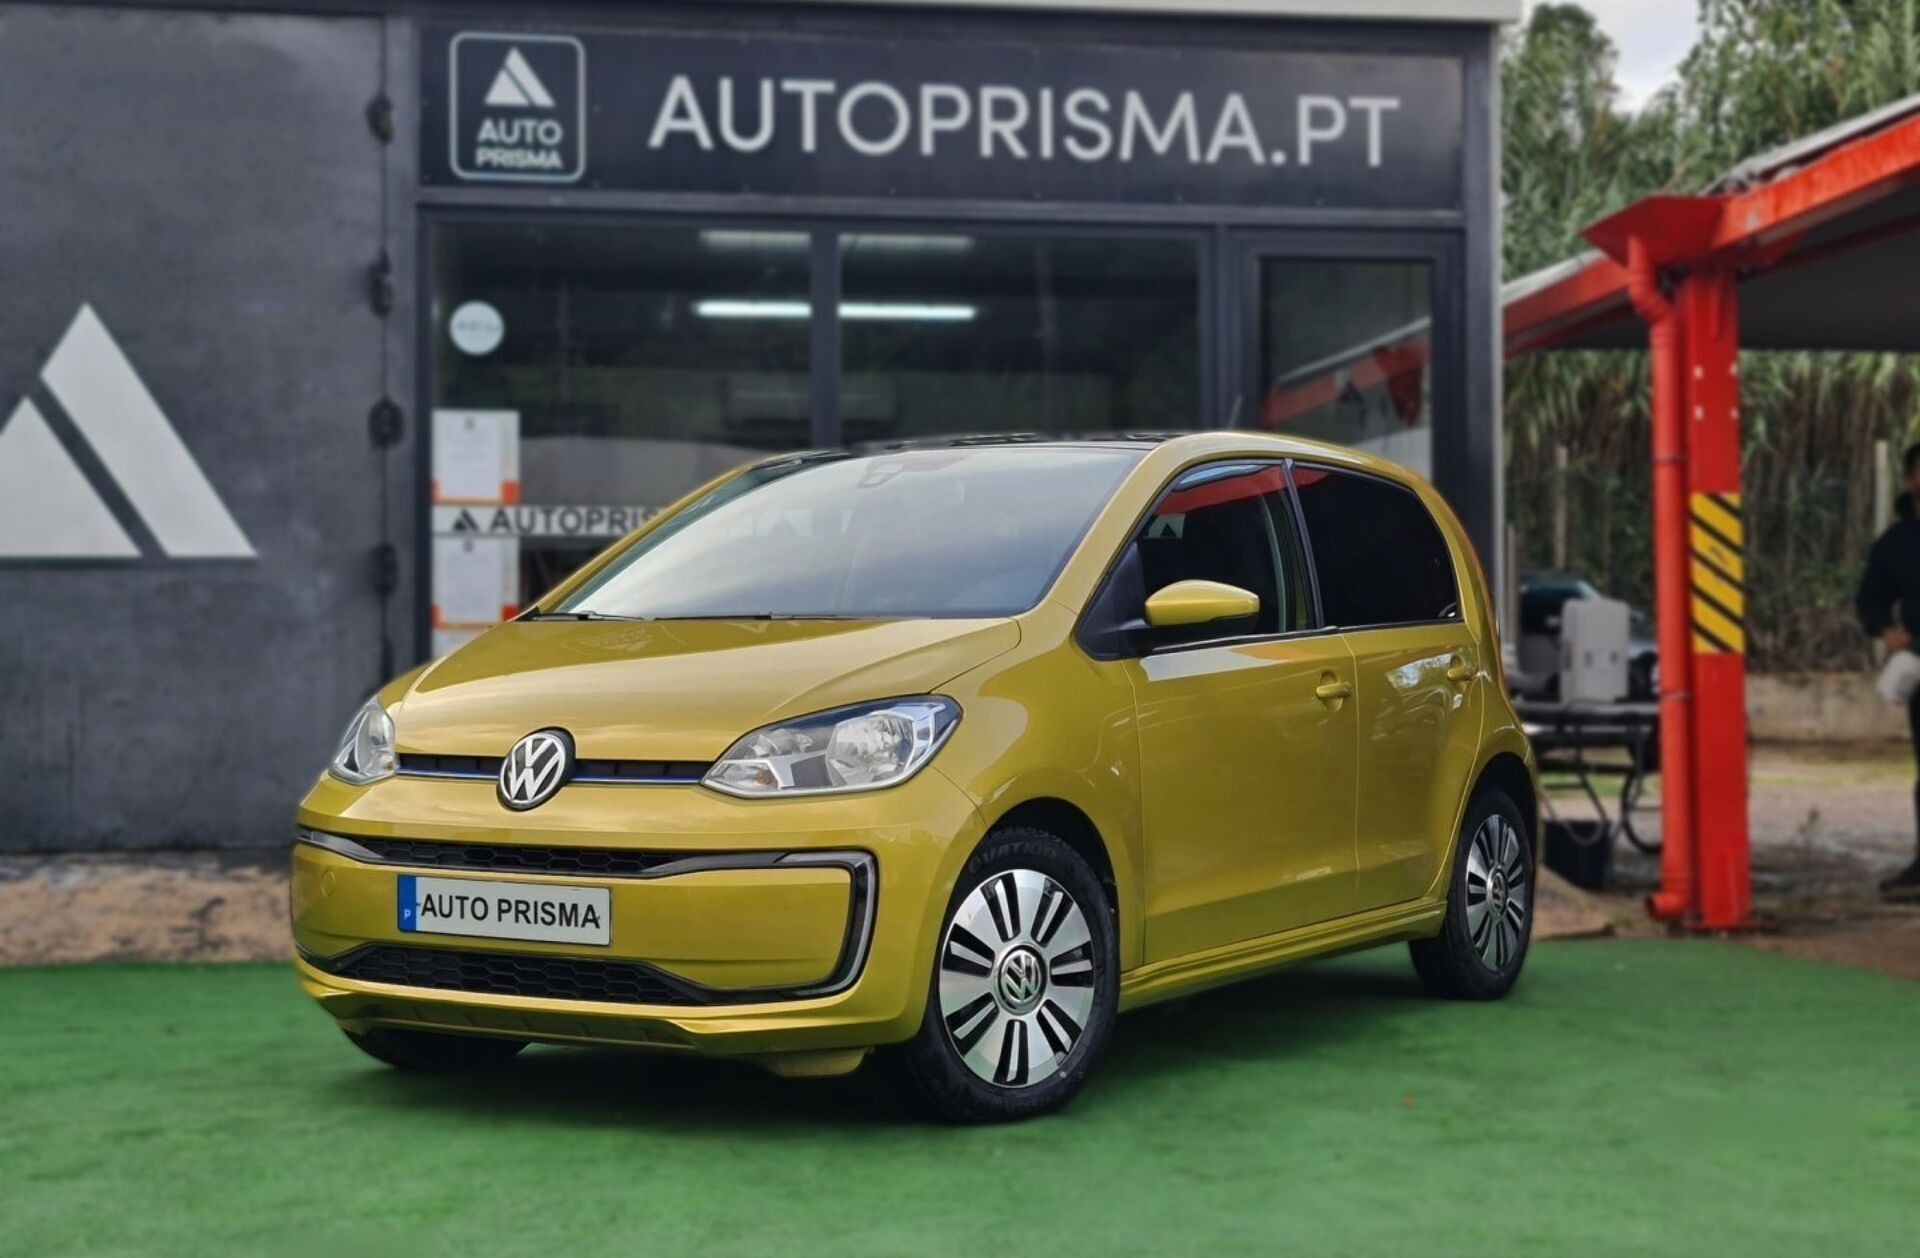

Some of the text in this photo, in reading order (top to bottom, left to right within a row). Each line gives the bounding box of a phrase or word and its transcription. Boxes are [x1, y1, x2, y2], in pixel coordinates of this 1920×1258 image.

[477, 117, 563, 146] AUTO
[647, 75, 1401, 167] AUTOPRISMA.PT
[475, 146, 563, 170] PRISMA
[403, 908, 412, 921] P
[421, 893, 601, 930] AUTO PRISMA
